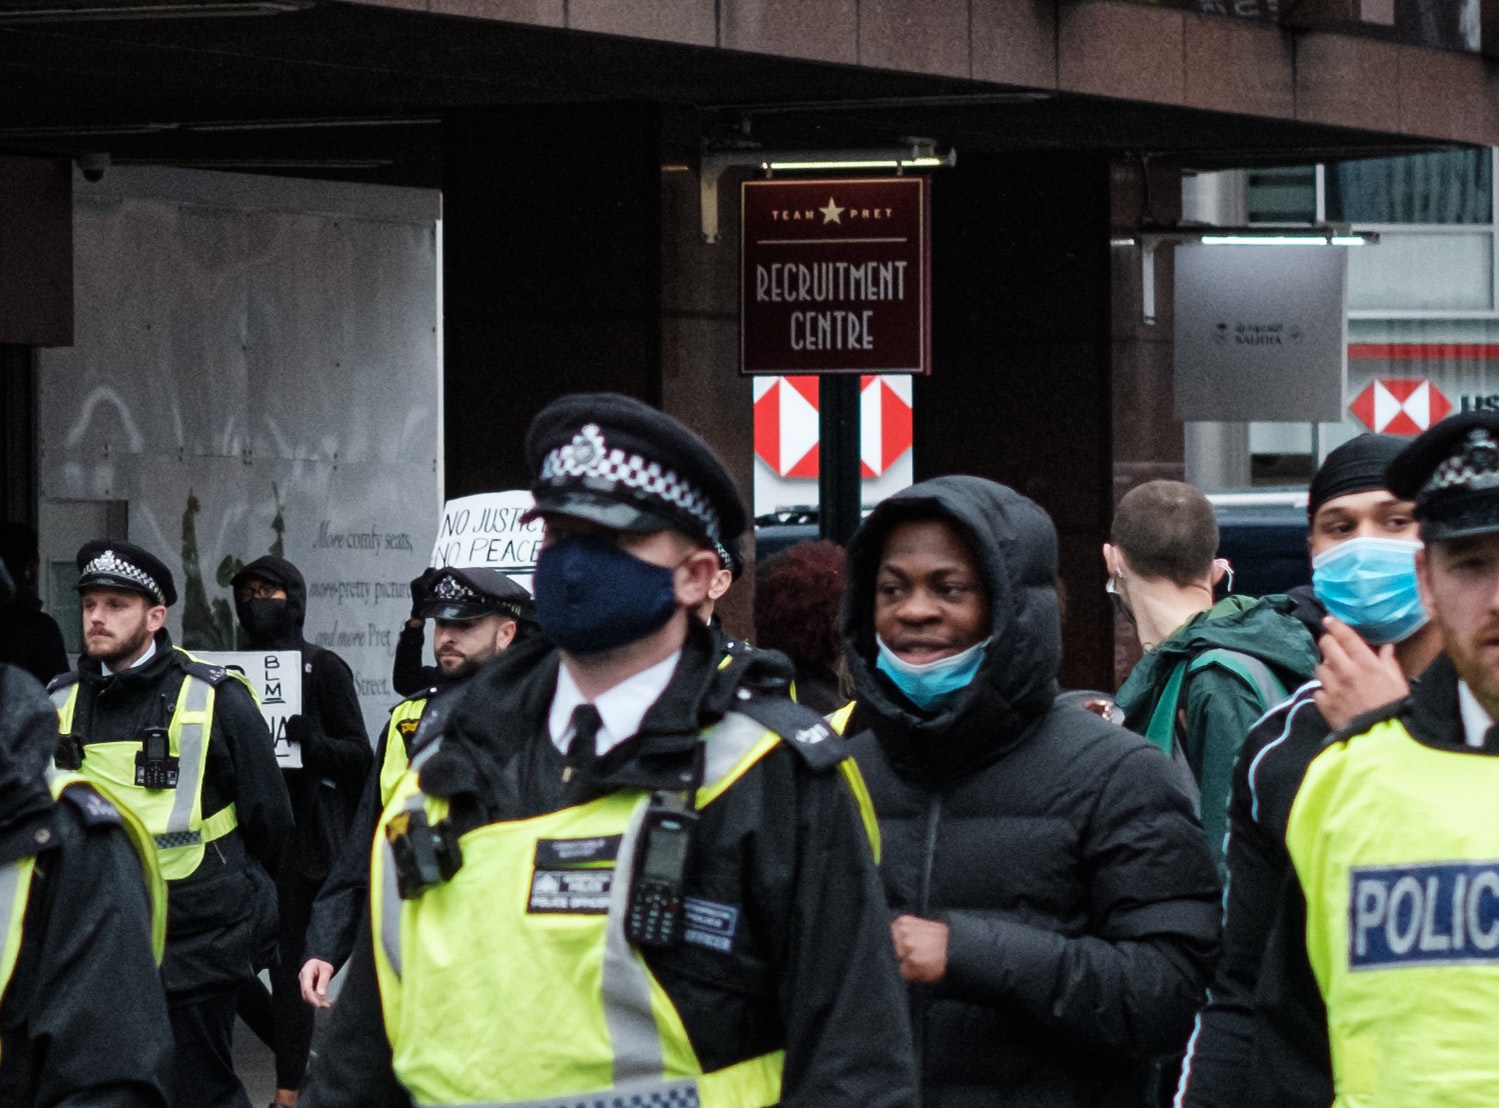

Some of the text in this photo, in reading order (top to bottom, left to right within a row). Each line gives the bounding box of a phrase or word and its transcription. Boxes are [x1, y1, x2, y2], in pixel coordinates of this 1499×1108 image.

[772, 208, 894, 221] TEAM PRET
[756, 260, 909, 303] RECRUITMENT
[790, 310, 874, 350] CENTRE
[441, 508, 470, 538] NO
[434, 537, 543, 567] NO PEACE
